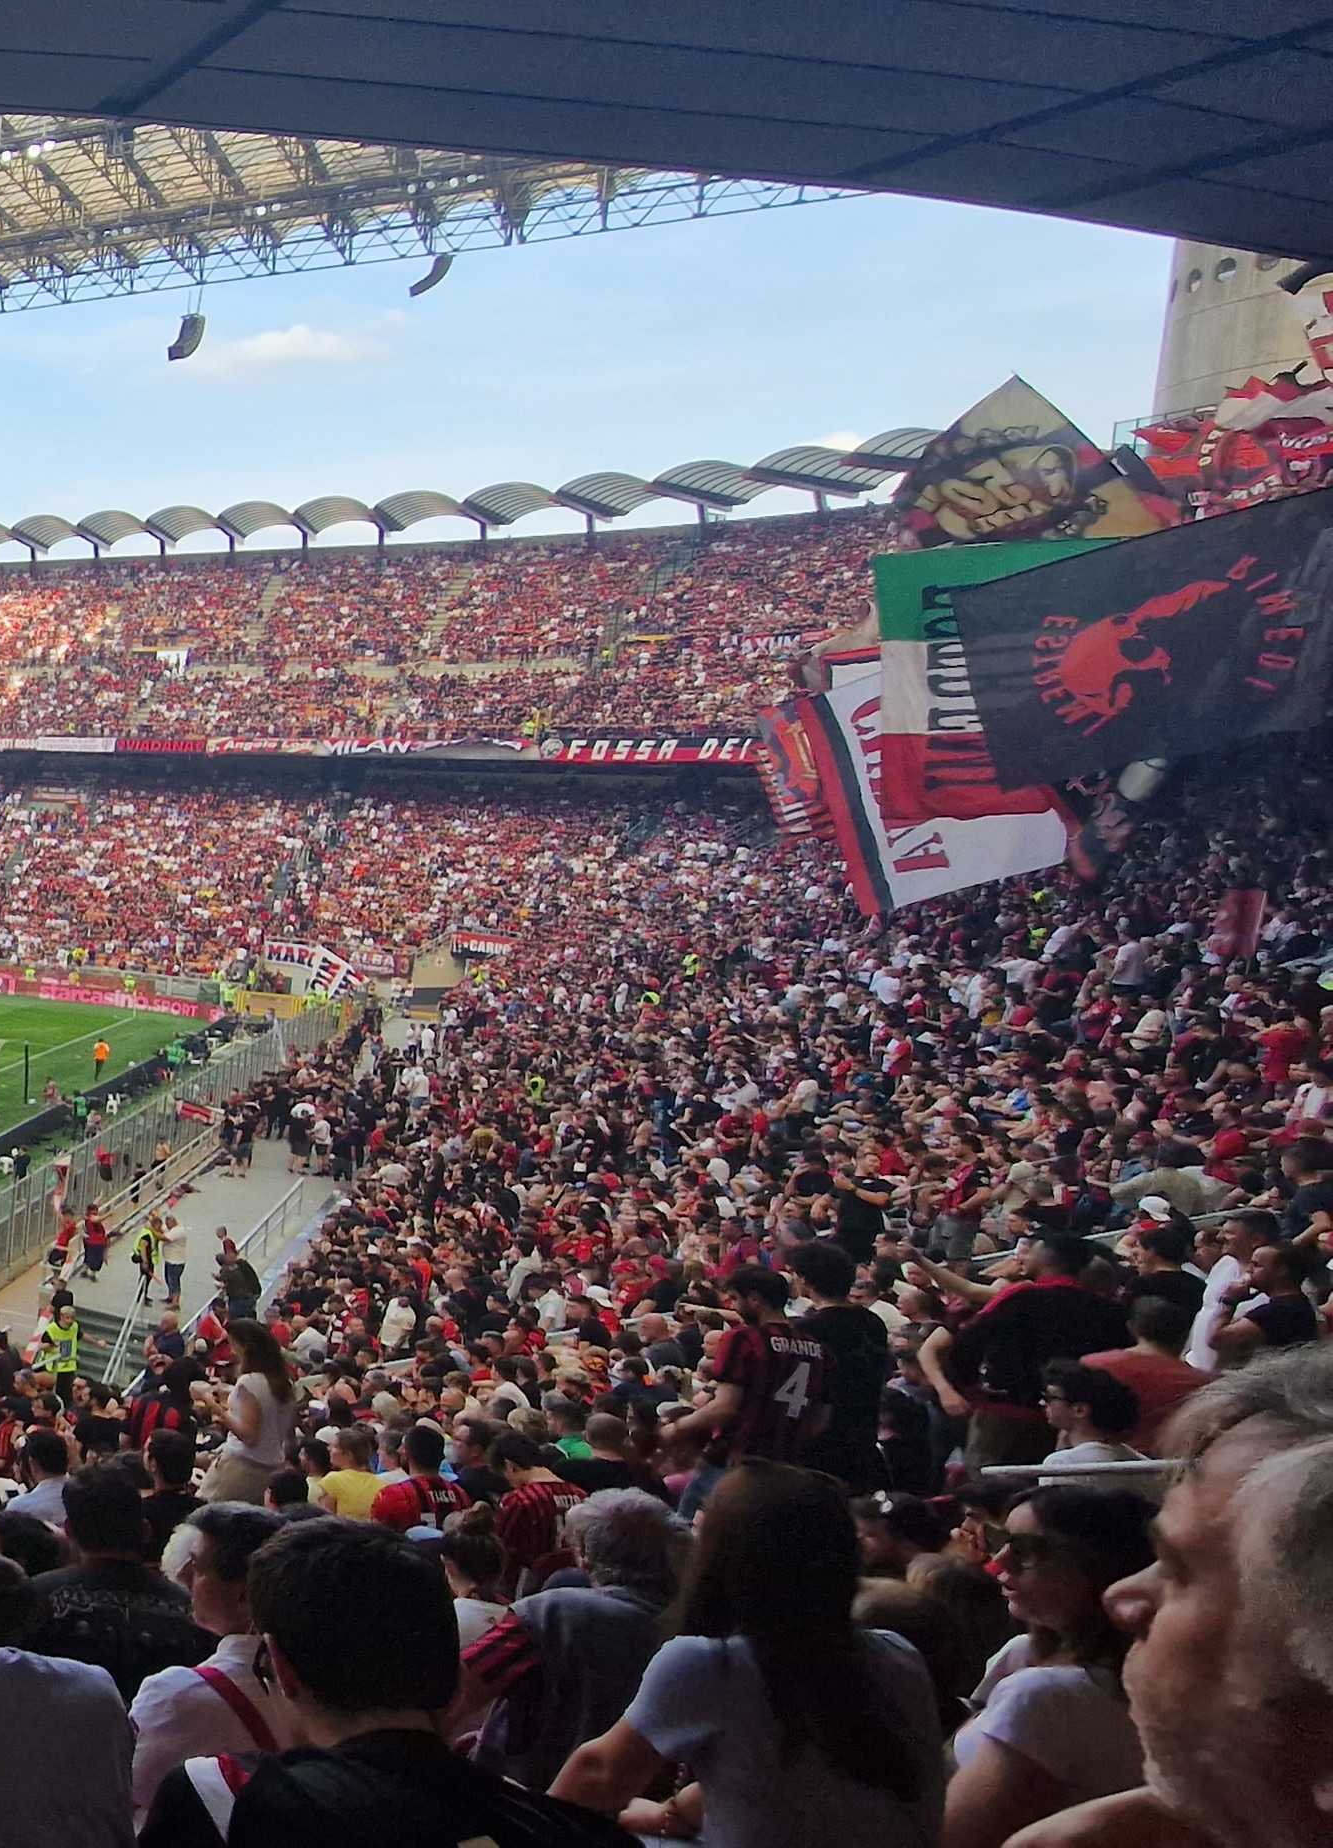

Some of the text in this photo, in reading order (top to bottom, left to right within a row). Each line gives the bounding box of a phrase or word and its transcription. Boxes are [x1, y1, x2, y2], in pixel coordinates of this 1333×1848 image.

[568, 737, 753, 760] FOSSA DEI
[773, 1361, 811, 1418] 4
